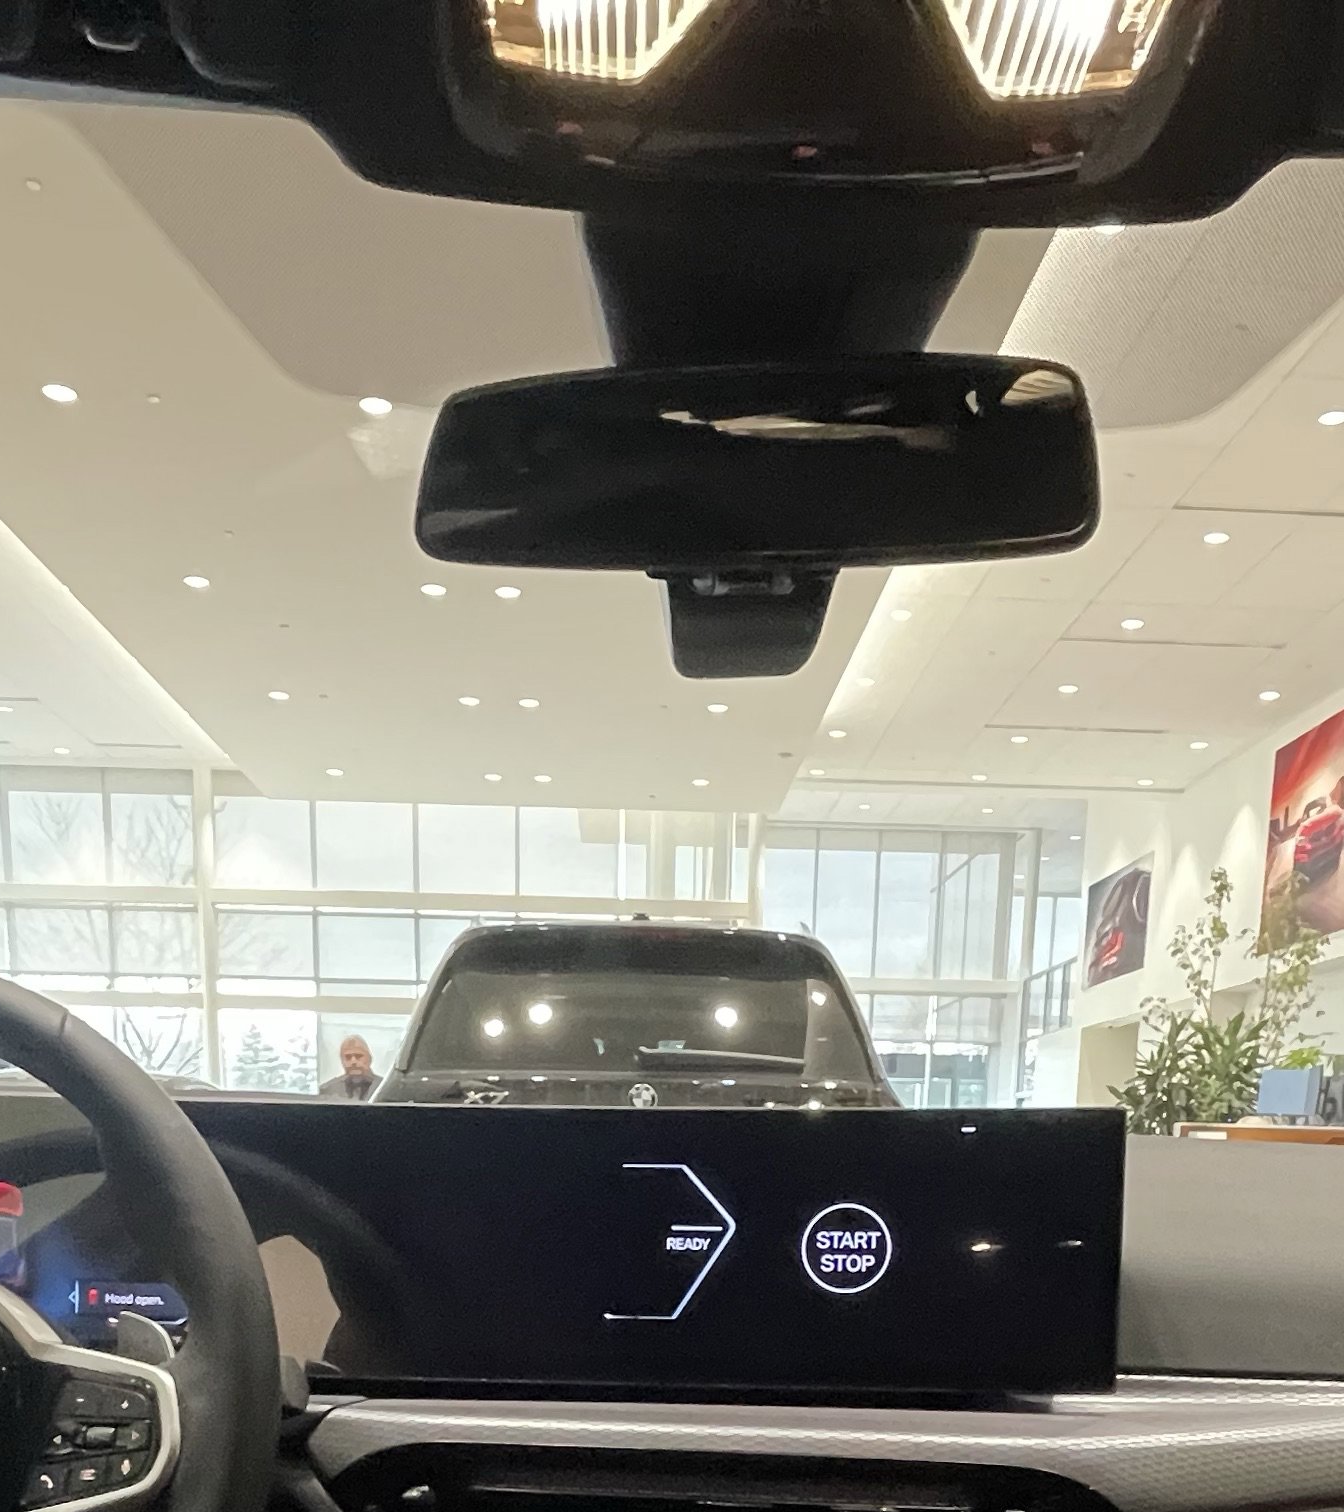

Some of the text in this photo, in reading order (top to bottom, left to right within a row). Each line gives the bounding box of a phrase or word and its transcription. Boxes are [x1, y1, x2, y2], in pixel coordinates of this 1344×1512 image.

[666, 1237, 711, 1251] READY
[816, 1231, 882, 1250] START
[820, 1254, 876, 1273] STOP
[104, 1293, 134, 1304] Hood
